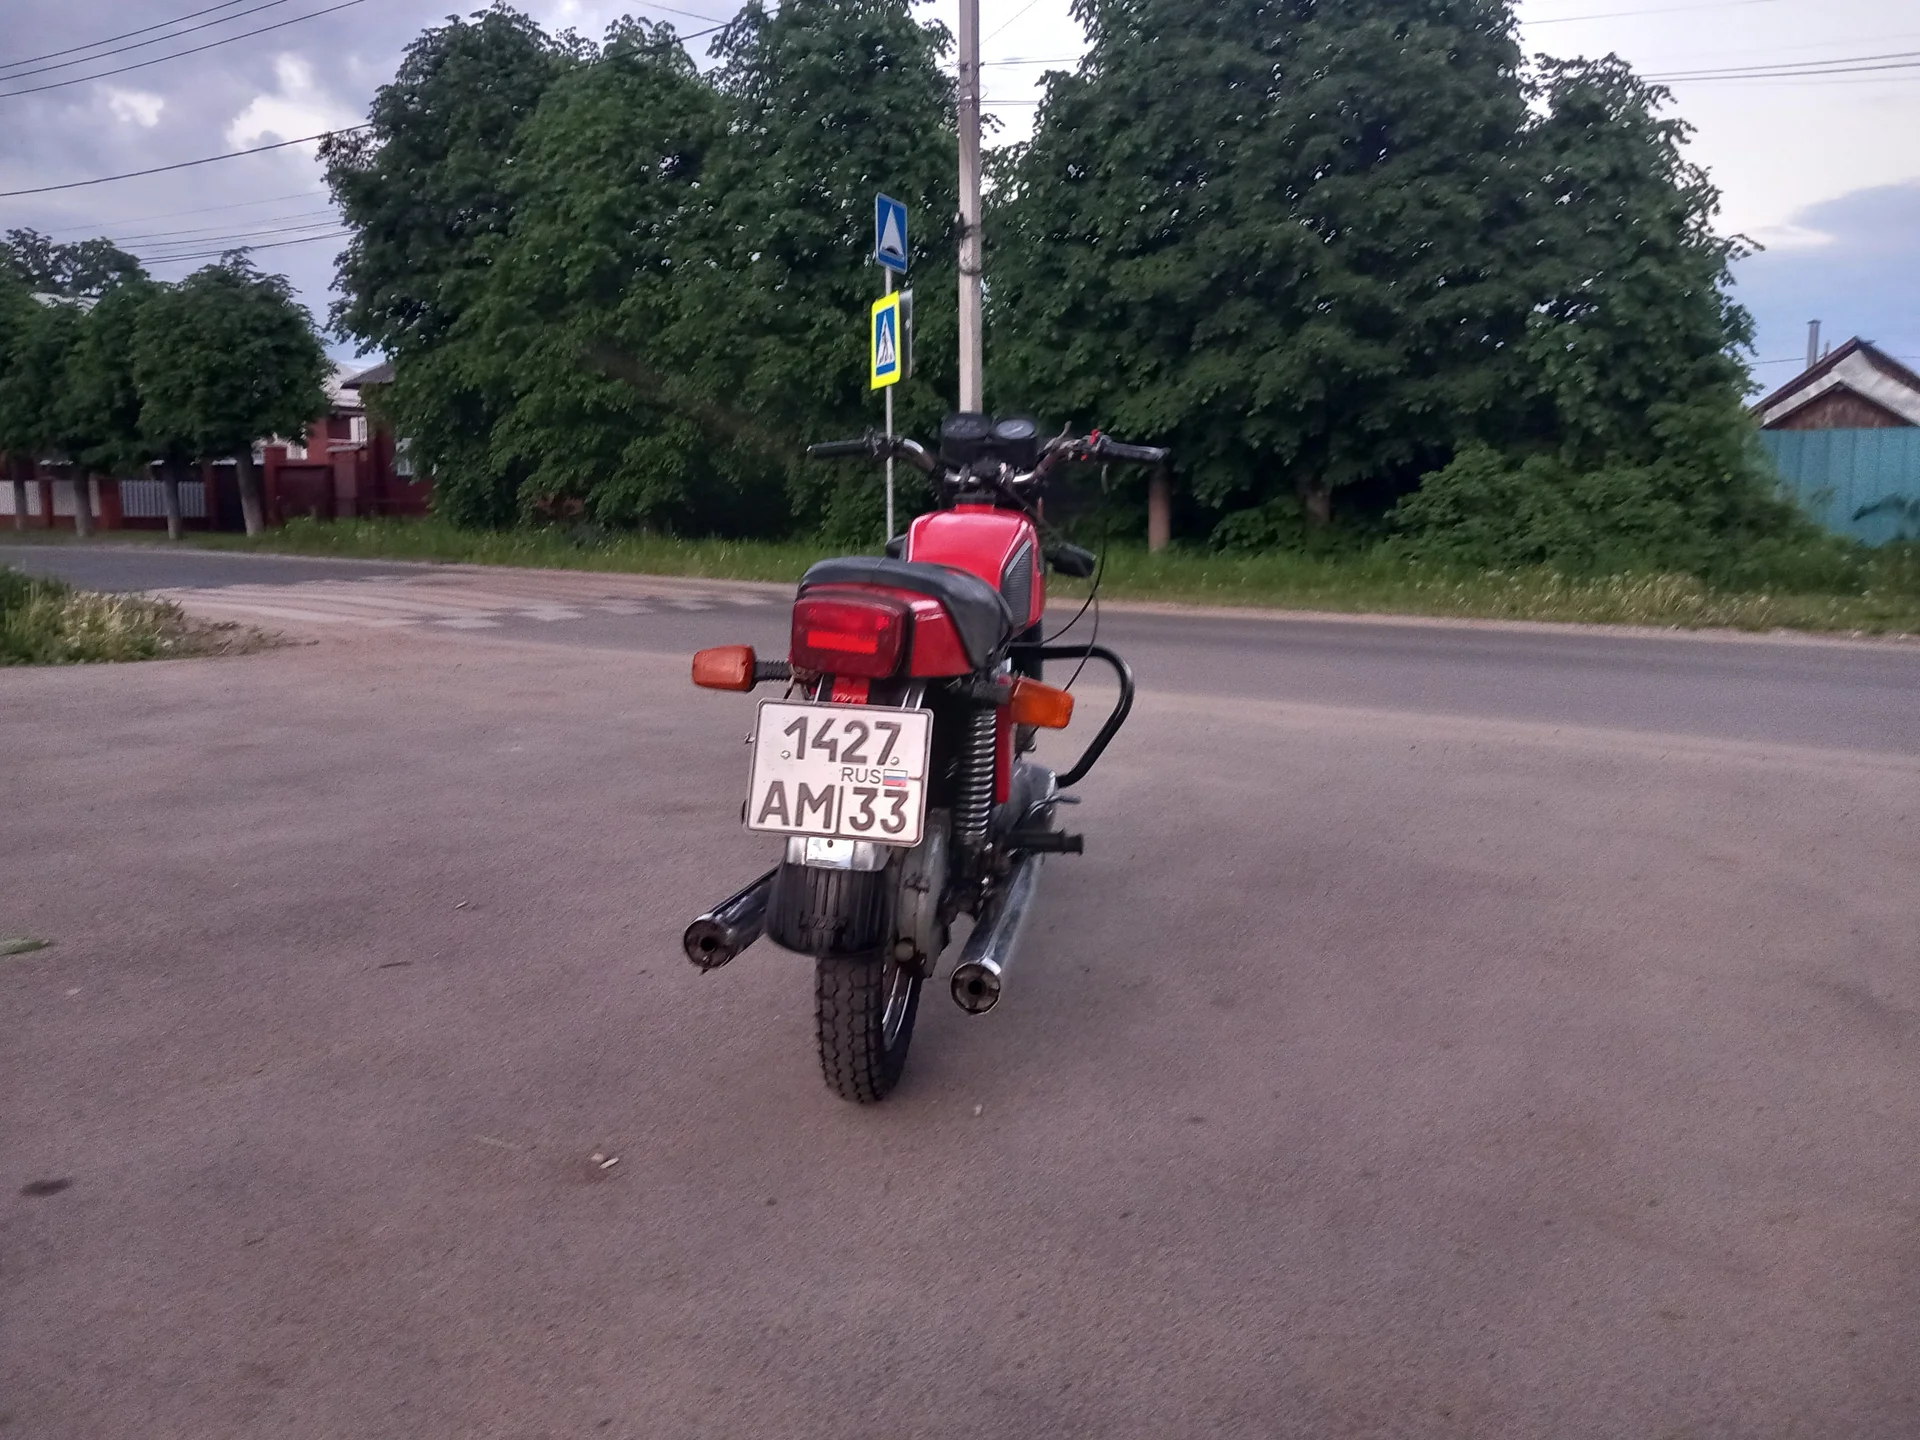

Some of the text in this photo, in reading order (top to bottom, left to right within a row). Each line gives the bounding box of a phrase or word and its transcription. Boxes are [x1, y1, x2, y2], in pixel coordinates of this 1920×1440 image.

[783, 716, 902, 766] 1427
[840, 766, 882, 785] RUS
[757, 780, 910, 835] AM 33
